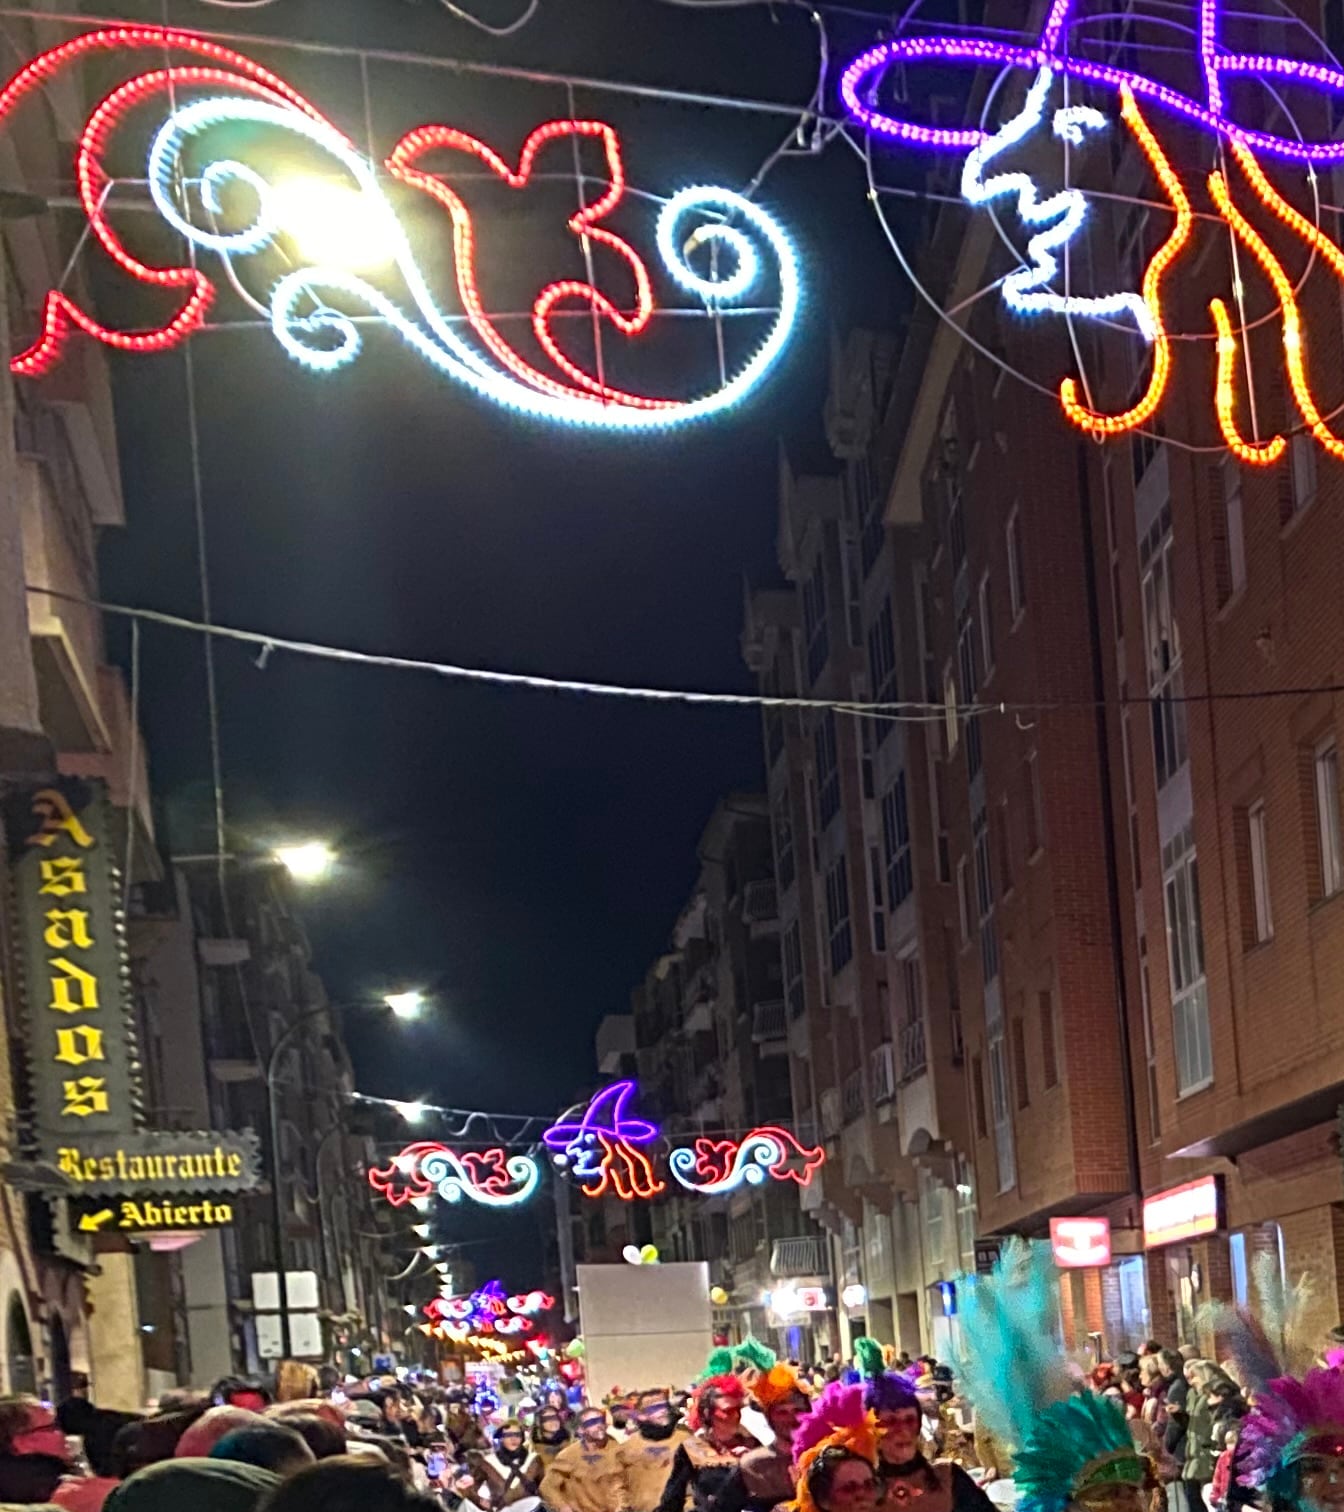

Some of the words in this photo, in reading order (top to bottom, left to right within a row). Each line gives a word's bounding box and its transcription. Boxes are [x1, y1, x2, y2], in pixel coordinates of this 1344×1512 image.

[24, 788, 110, 1118] Asados
[58, 1146, 243, 1182] Restaurante
[118, 1201, 233, 1228] Abierto
